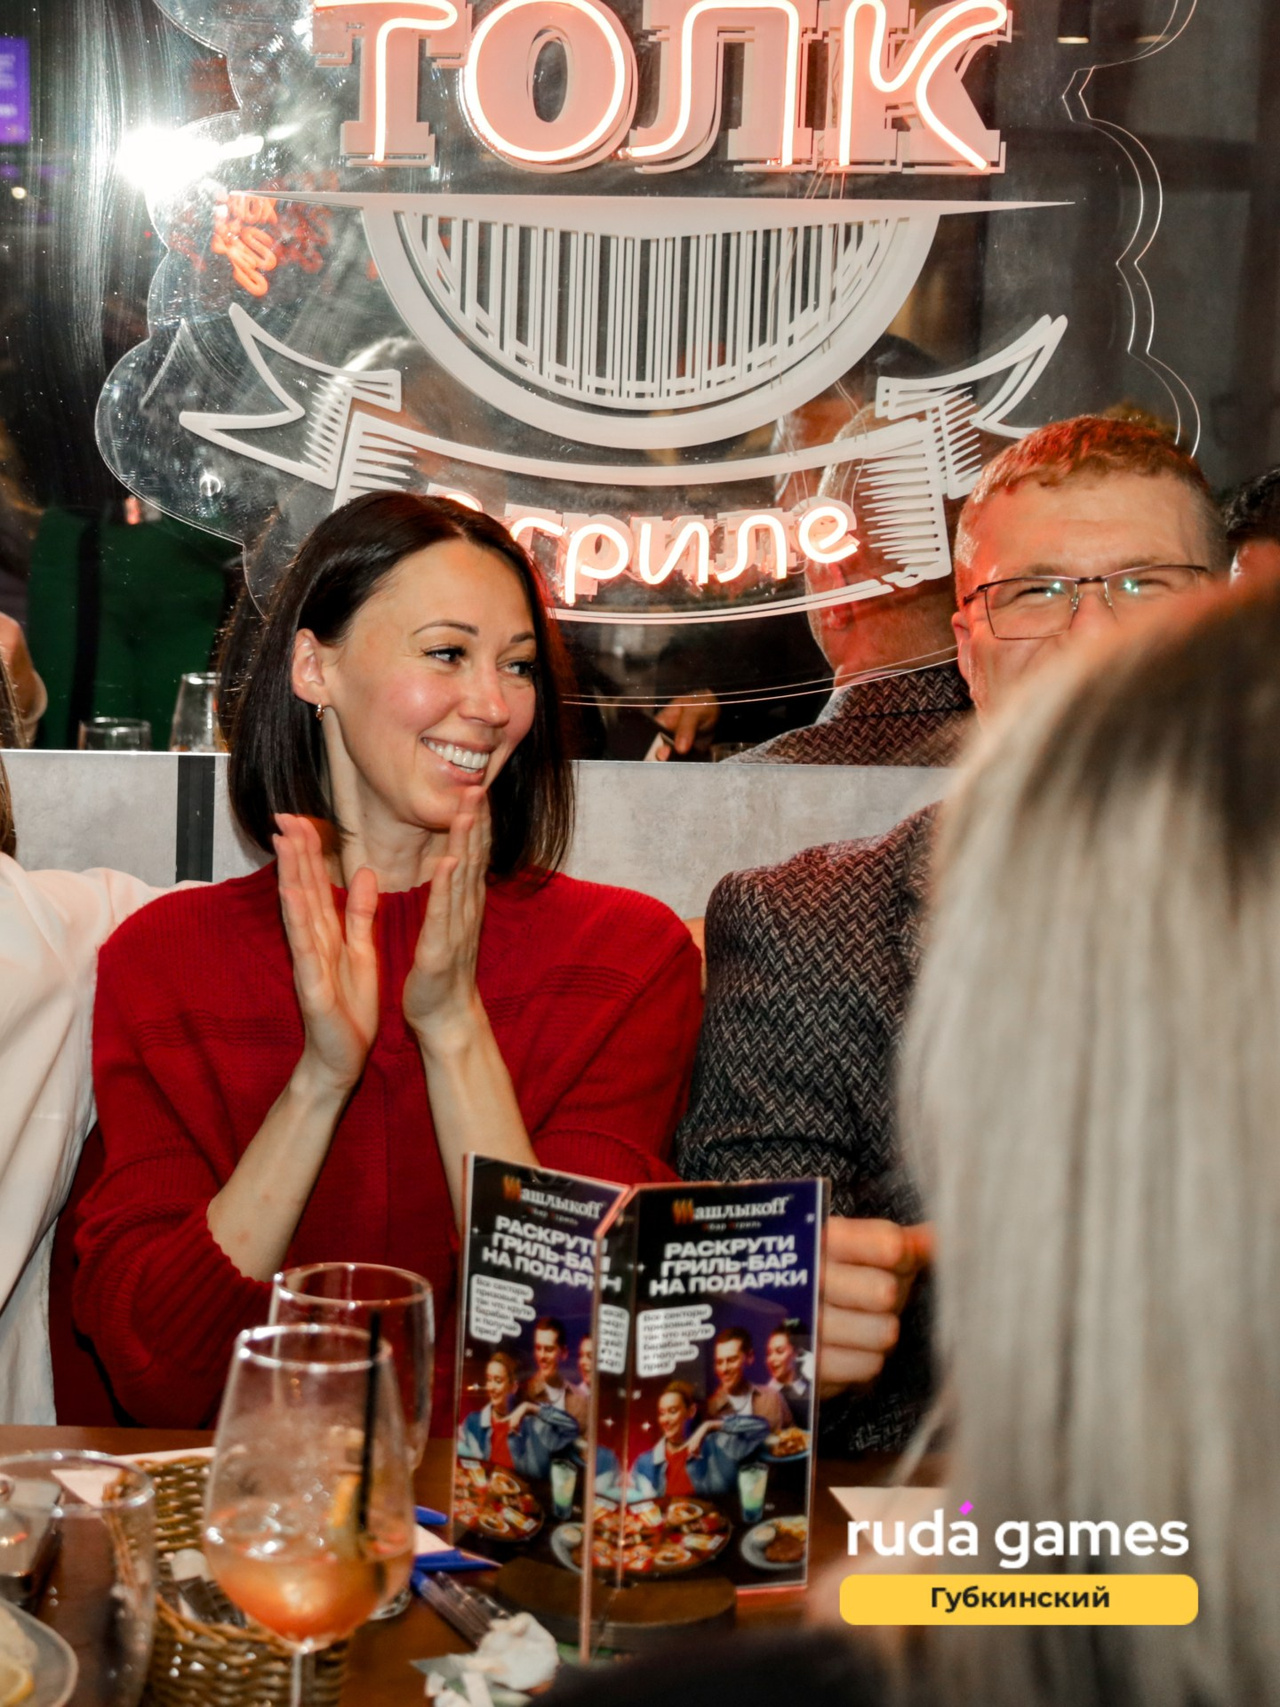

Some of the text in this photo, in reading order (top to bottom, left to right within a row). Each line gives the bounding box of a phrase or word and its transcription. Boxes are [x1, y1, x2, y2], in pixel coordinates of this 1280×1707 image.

[308, 0, 1012, 174] ТОЛК
[482, 1246, 512, 1268] НА
[492, 1231, 595, 1273] ГРИЛЬ-БА
[664, 1235, 795, 1260] РАСКРУТИ
[660, 1252, 798, 1277] ГРИЛЬ-БАР
[649, 1269, 808, 1297] НА ПОДАРКИ
